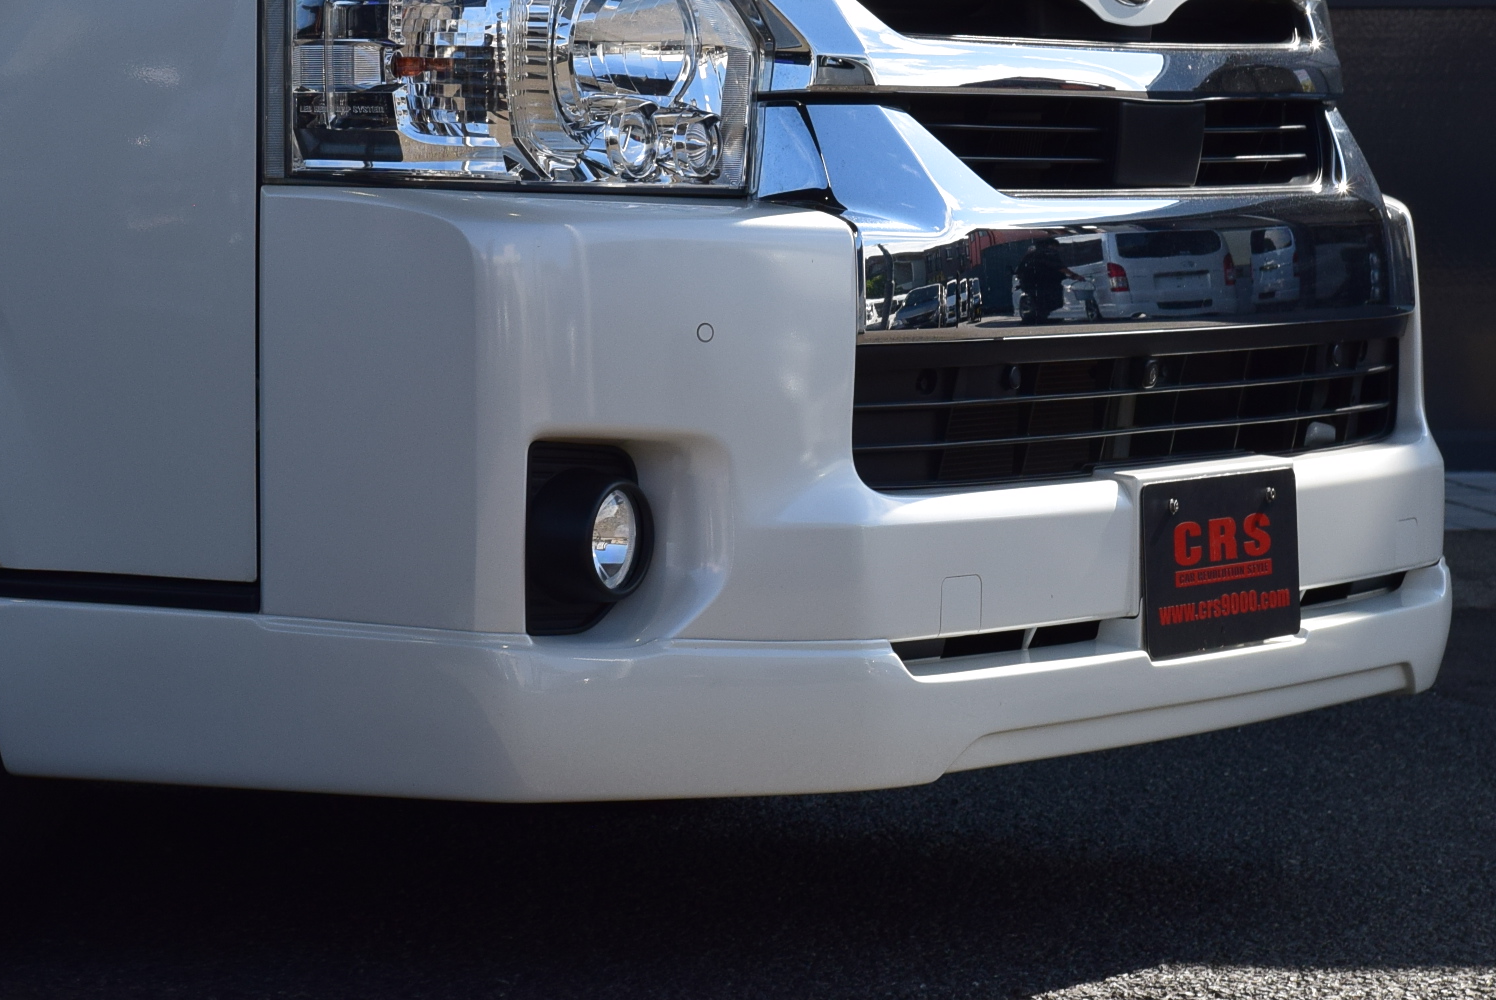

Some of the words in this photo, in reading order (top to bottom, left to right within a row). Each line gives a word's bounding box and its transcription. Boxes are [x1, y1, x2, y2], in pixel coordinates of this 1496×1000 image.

[1173, 512, 1272, 566] CRS
[1179, 572, 1195, 584] CAR
[1197, 565, 1245, 581] REVOLUTION
[1247, 562, 1269, 574] STYLE
[1159, 588, 1291, 626] www.crs9000.com
